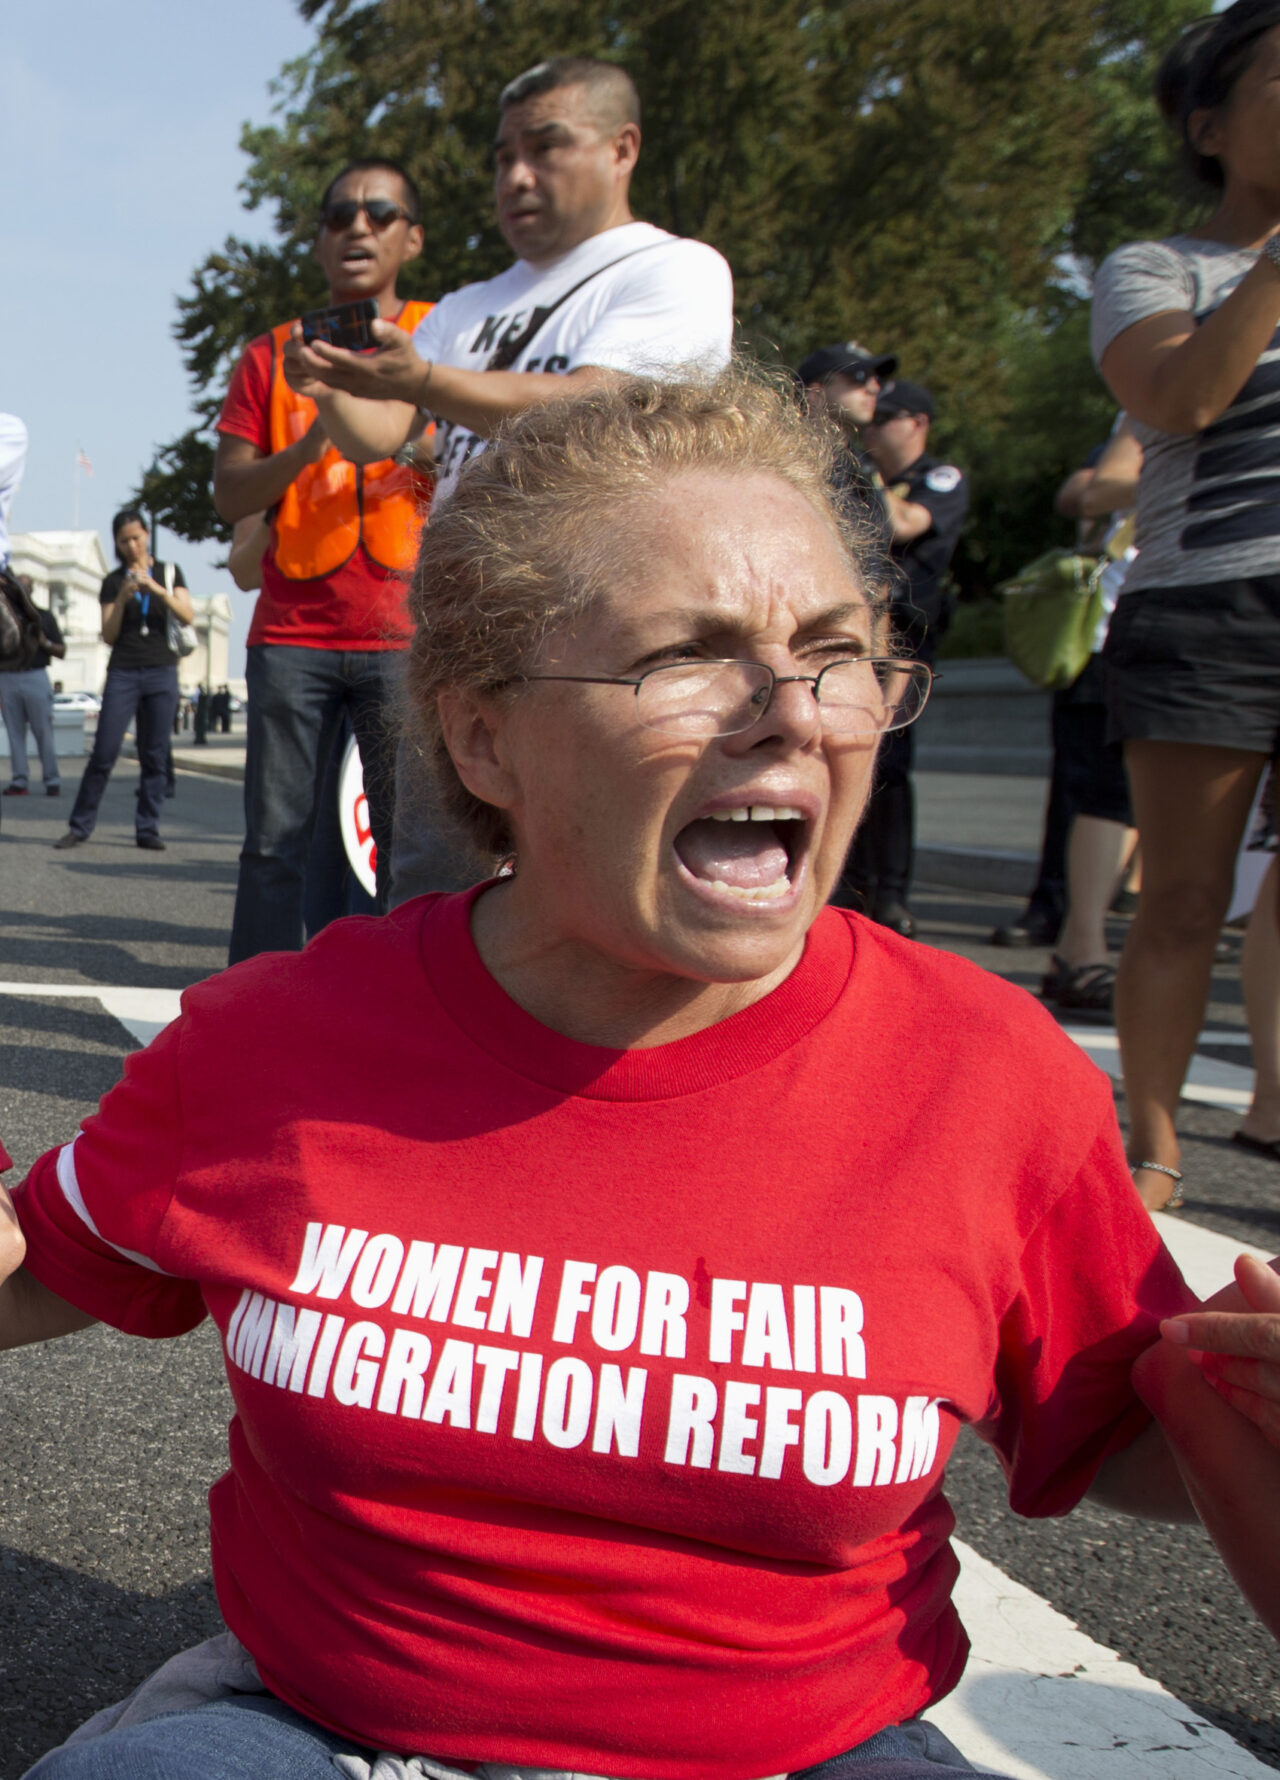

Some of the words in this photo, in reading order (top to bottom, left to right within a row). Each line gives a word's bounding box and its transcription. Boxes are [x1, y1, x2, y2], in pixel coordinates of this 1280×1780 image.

[225, 1288, 647, 1458] IMMIGRATION
[664, 1372, 941, 1488] REFORM
[289, 1222, 544, 1338] WOMEN
[552, 1260, 690, 1358] FOR
[709, 1278, 867, 1379] FAIR
